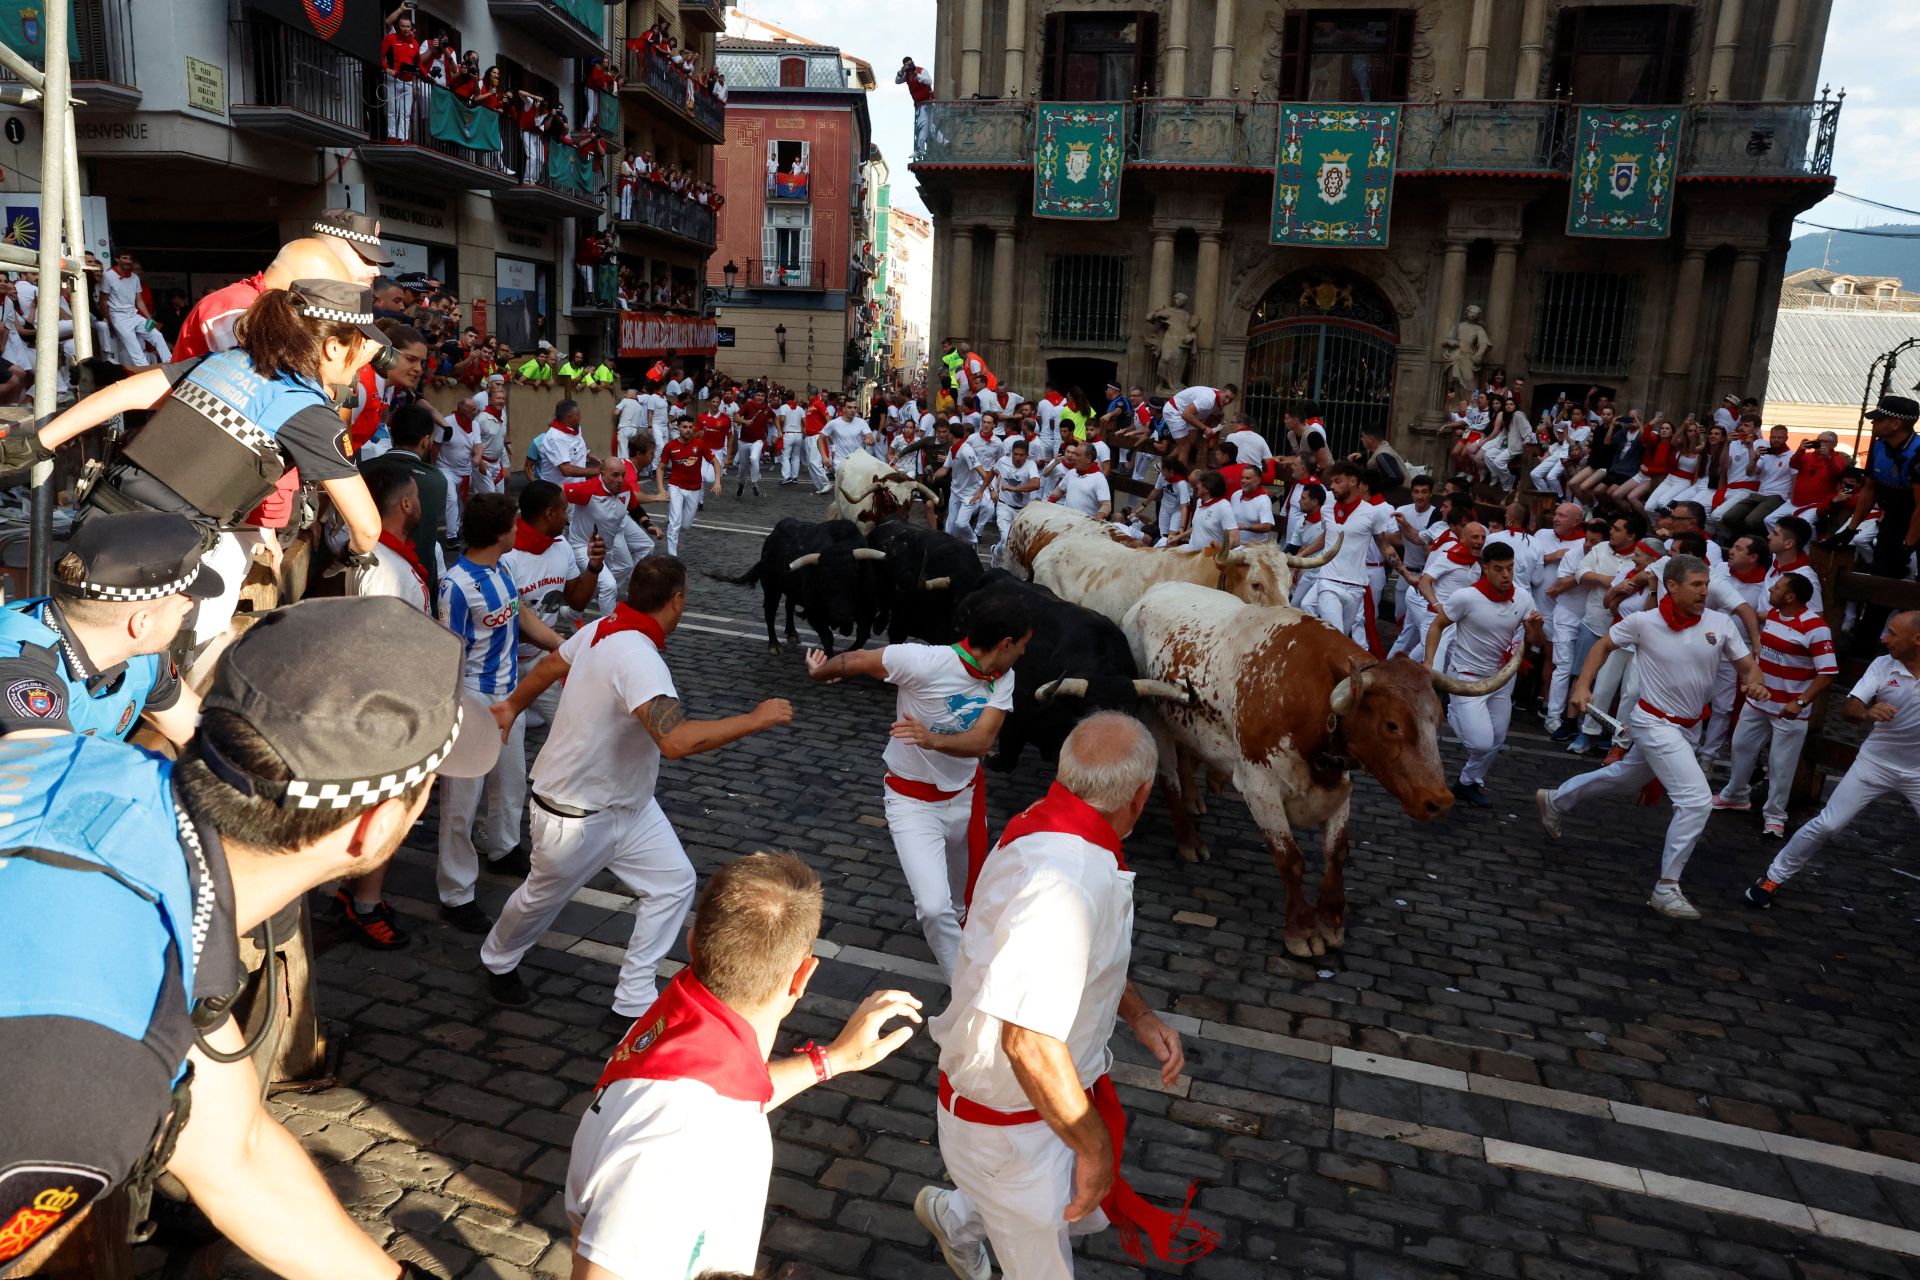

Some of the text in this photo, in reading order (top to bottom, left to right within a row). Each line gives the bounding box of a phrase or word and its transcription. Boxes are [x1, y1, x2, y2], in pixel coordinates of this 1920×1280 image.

[200, 67, 211, 76] PLAZA
[194, 74, 218, 87] CONSISTORIAL
[75, 123, 148, 139] BIENVENUE
[622, 319, 634, 349] LOS
[518, 577, 566, 596] SAN FERMIN
[11, 682, 42, 693] PAMPLONA
